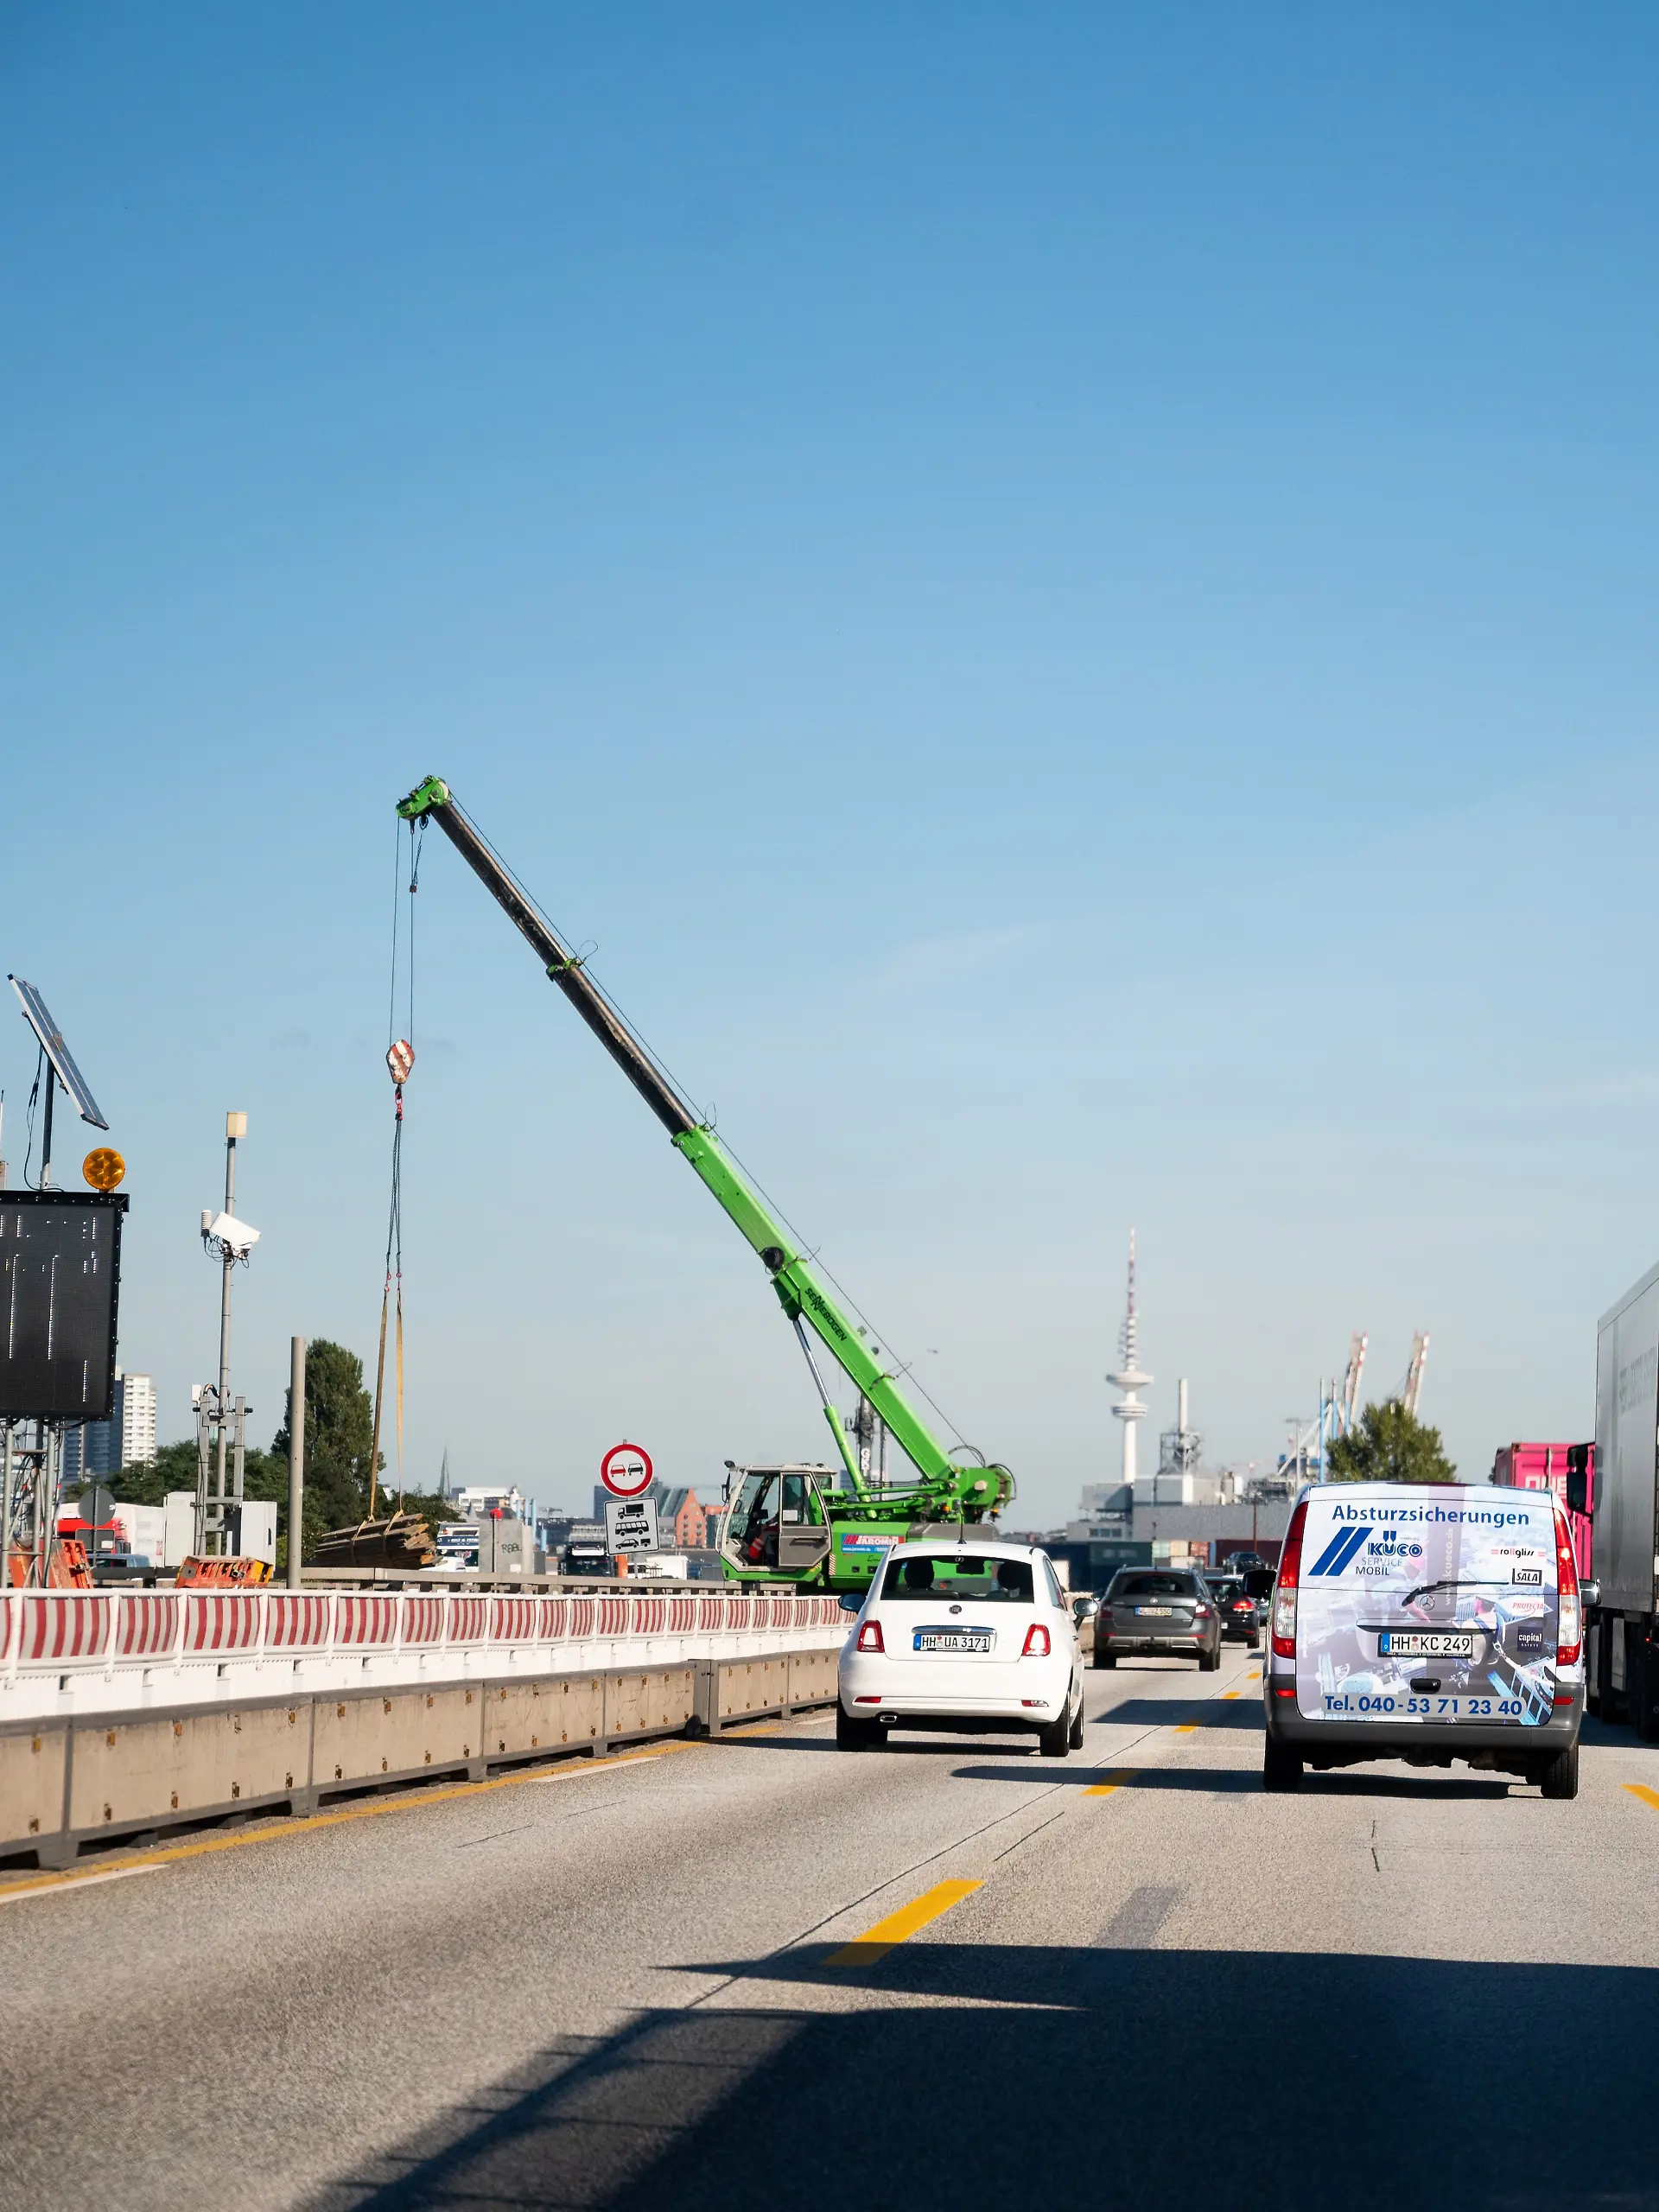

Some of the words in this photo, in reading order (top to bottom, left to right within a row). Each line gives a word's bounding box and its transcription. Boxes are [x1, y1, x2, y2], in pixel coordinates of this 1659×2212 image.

[804, 1287, 848, 1341] SENNEBOGEN
[1332, 1504, 1529, 1528] Absturzsicherungen
[1368, 1530, 1423, 1557] KÜCO
[1500, 1548, 1535, 1559] rollgliss
[1362, 1557, 1403, 1567] SERVICE
[1356, 1566, 1390, 1576] MOBIL
[1516, 1573, 1538, 1582] SALA
[922, 1637, 937, 1647] HH
[944, 1637, 958, 1647] UA
[961, 1637, 988, 1649] 3171
[1391, 1636, 1410, 1649] HH
[1421, 1637, 1440, 1650] KC
[1443, 1637, 1470, 1651] 249
[1518, 1633, 1542, 1643] capital
[1325, 1695, 1355, 1711] Tel.
[1438, 1699, 1459, 1713] 71
[1468, 1699, 1491, 1714] 23
[1497, 1700, 1522, 1715] 40
